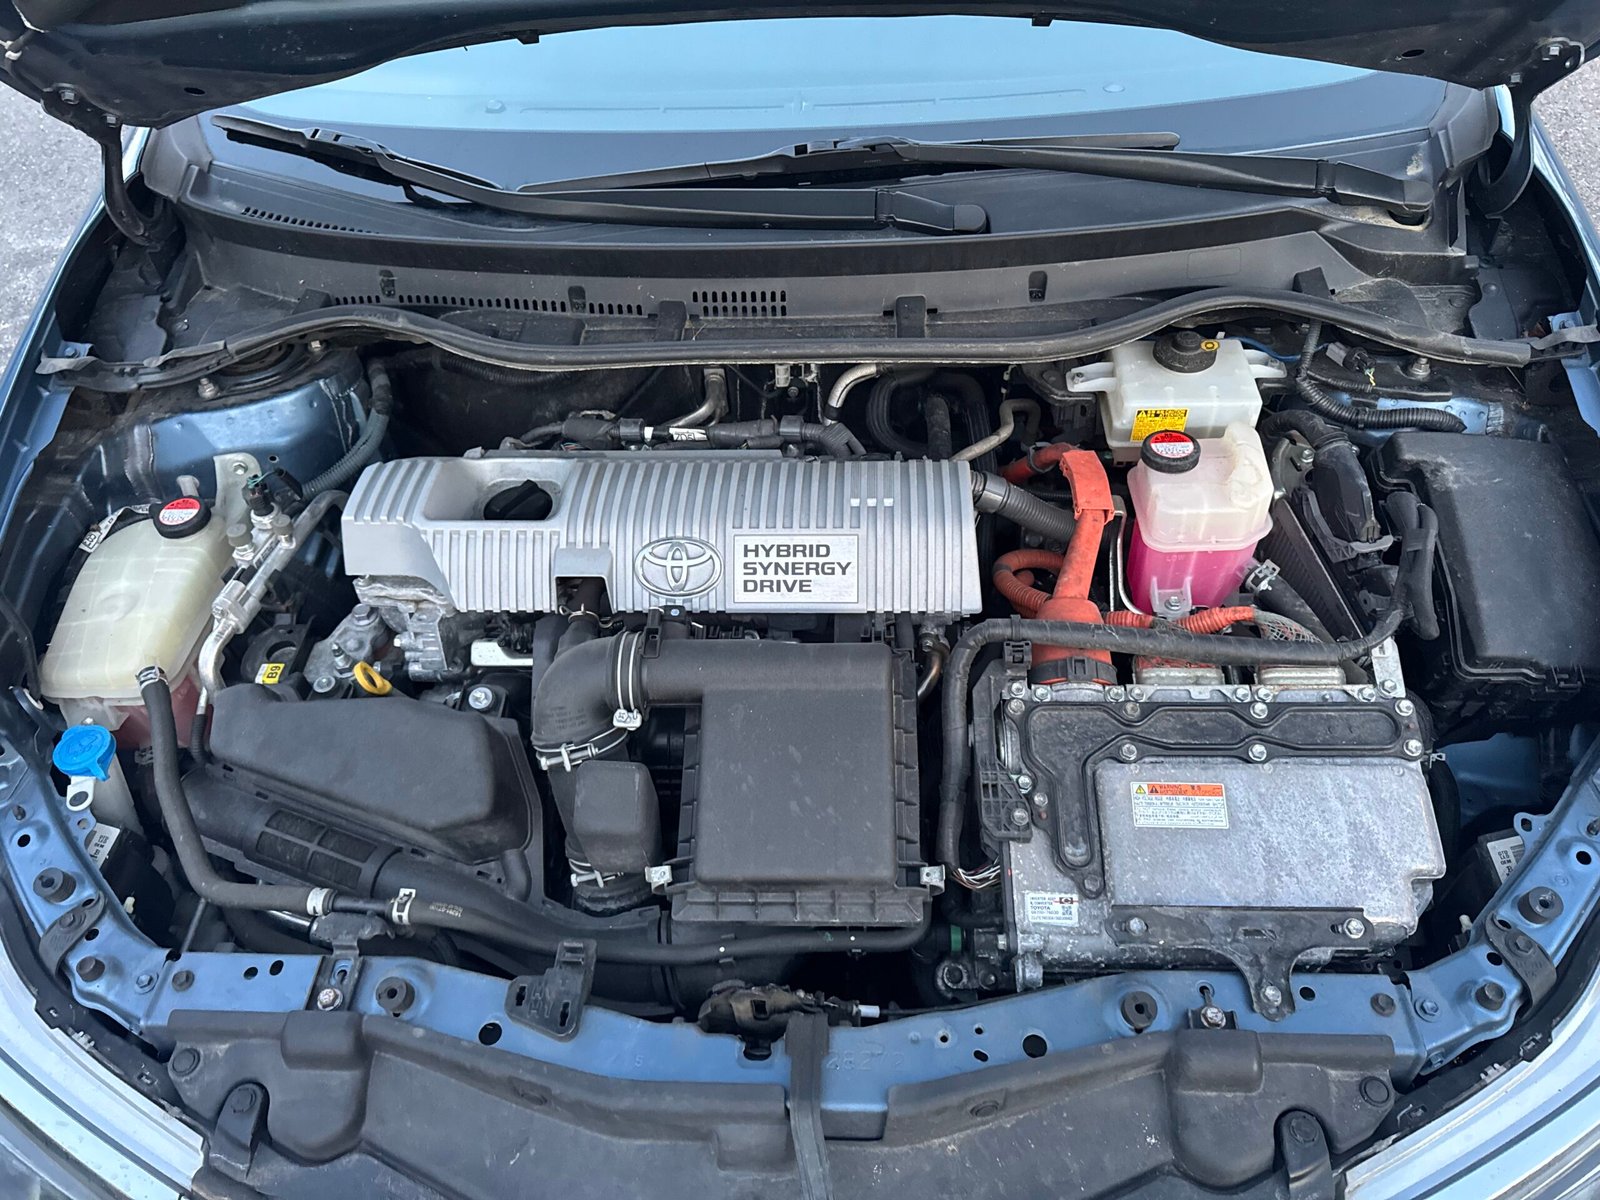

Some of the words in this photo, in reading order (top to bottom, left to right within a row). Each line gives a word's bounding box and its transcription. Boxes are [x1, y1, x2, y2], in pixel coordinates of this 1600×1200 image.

[743, 544, 831, 558] HYBRID
[743, 561, 852, 576] SYNERGY
[743, 579, 813, 593] DRIVE
[266, 665, 281, 679] B9
